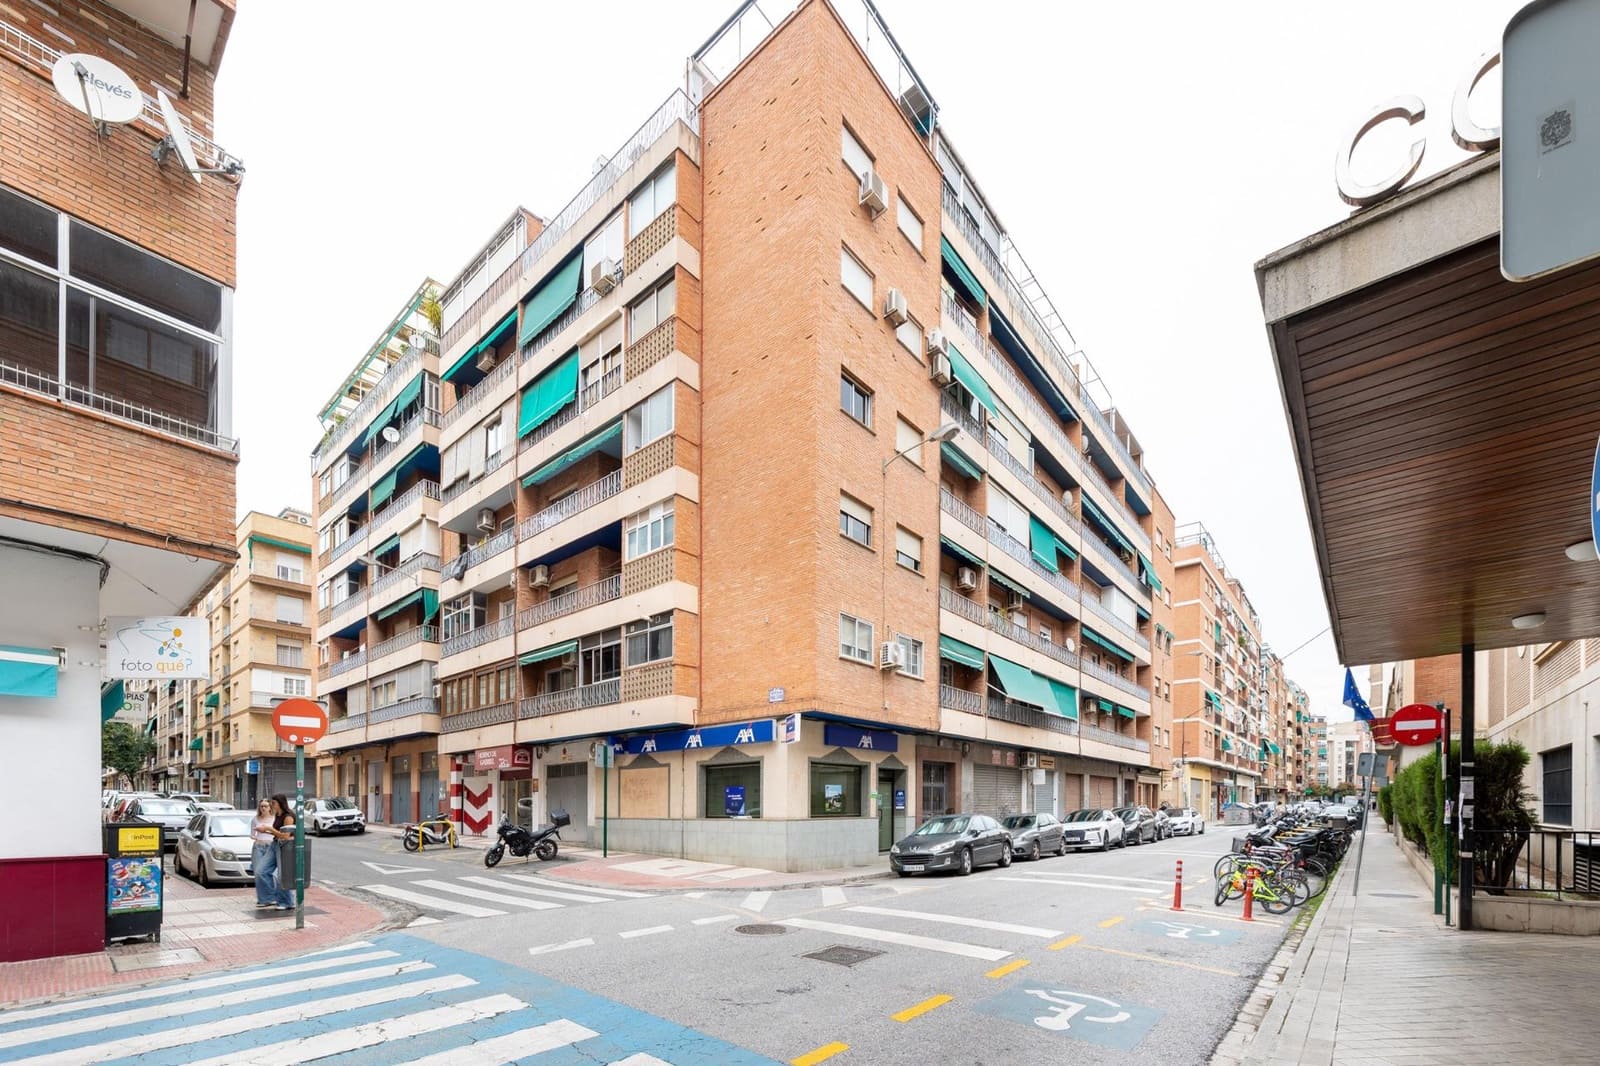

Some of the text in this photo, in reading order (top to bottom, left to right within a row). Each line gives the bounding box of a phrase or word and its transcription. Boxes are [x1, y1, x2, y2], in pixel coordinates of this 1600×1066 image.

[120, 658, 193, 674] foto qué?
[684, 733, 703, 749] AXA
[733, 727, 756, 744] AXA
[857, 734, 873, 749] AXA
[613, 743, 624, 751] AXA
[641, 738, 657, 753] AXA
